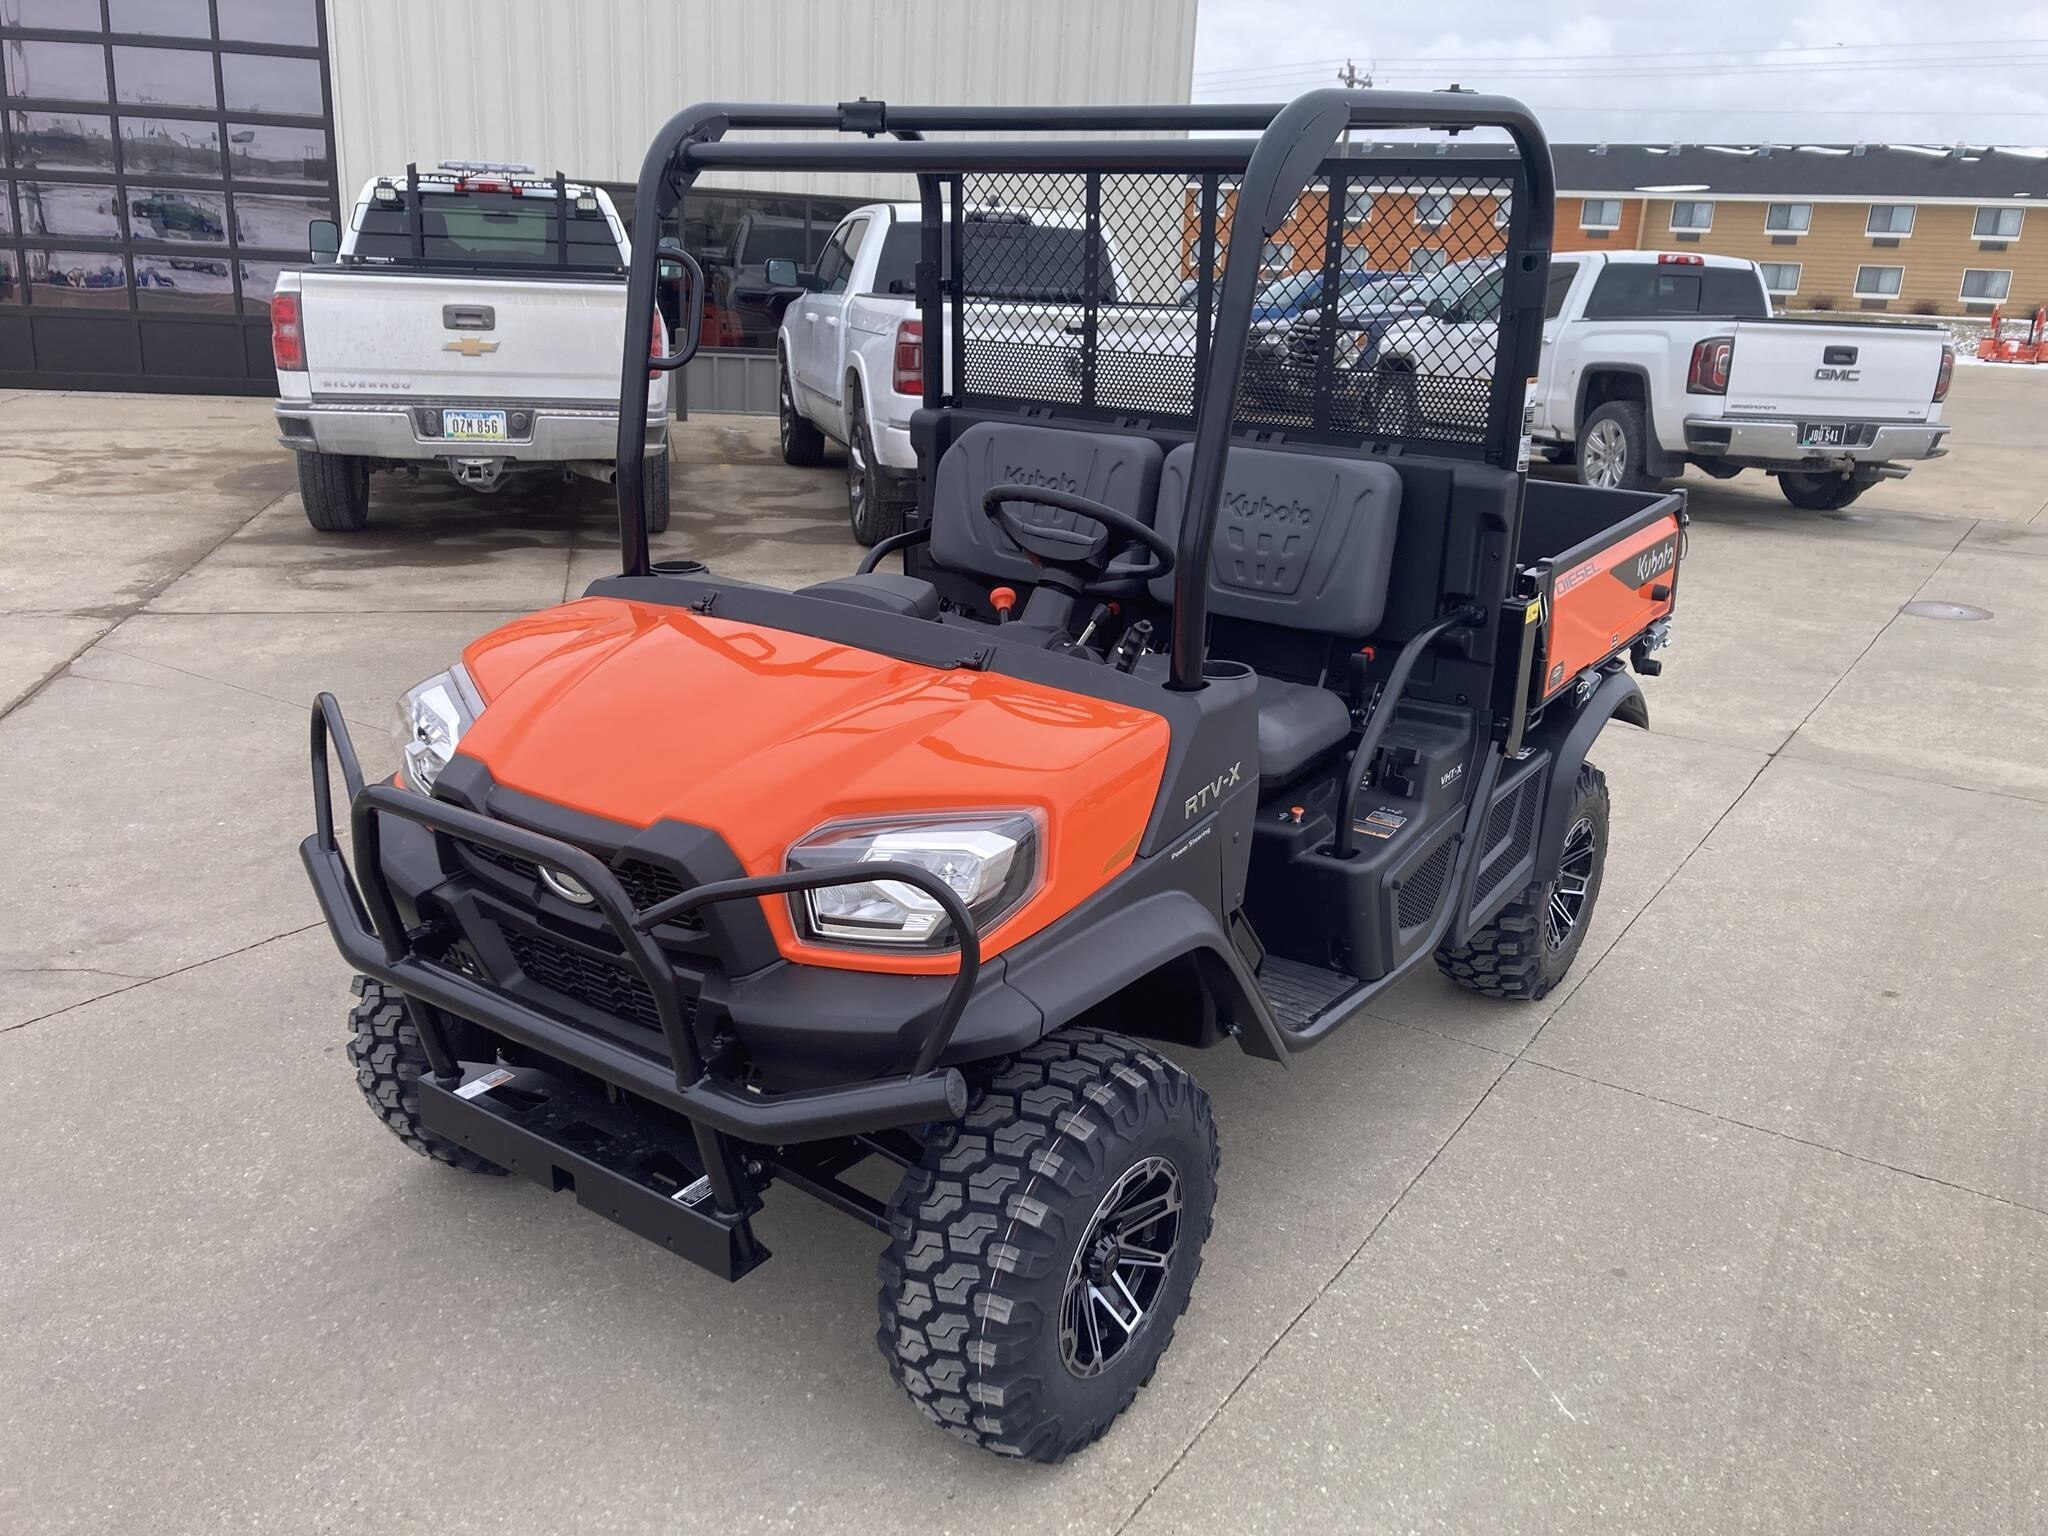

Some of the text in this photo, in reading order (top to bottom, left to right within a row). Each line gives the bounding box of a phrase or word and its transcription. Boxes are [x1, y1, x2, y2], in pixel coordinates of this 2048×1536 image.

[419, 175, 460, 183] BACK
[323, 381, 411, 389] SILVERADO
[1815, 369, 1860, 381] GMC
[477, 420, 498, 433] 856
[1825, 430, 1838, 442] 541
[1003, 465, 1077, 493] Kubota
[1224, 492, 1313, 524] Kubota
[1637, 541, 1674, 580] Kubota
[1556, 562, 1600, 595] DIESEL
[1440, 763, 1463, 785] VHT-X
[1185, 760, 1241, 820] RTV-X
[1171, 827, 1211, 860] Power Steering
